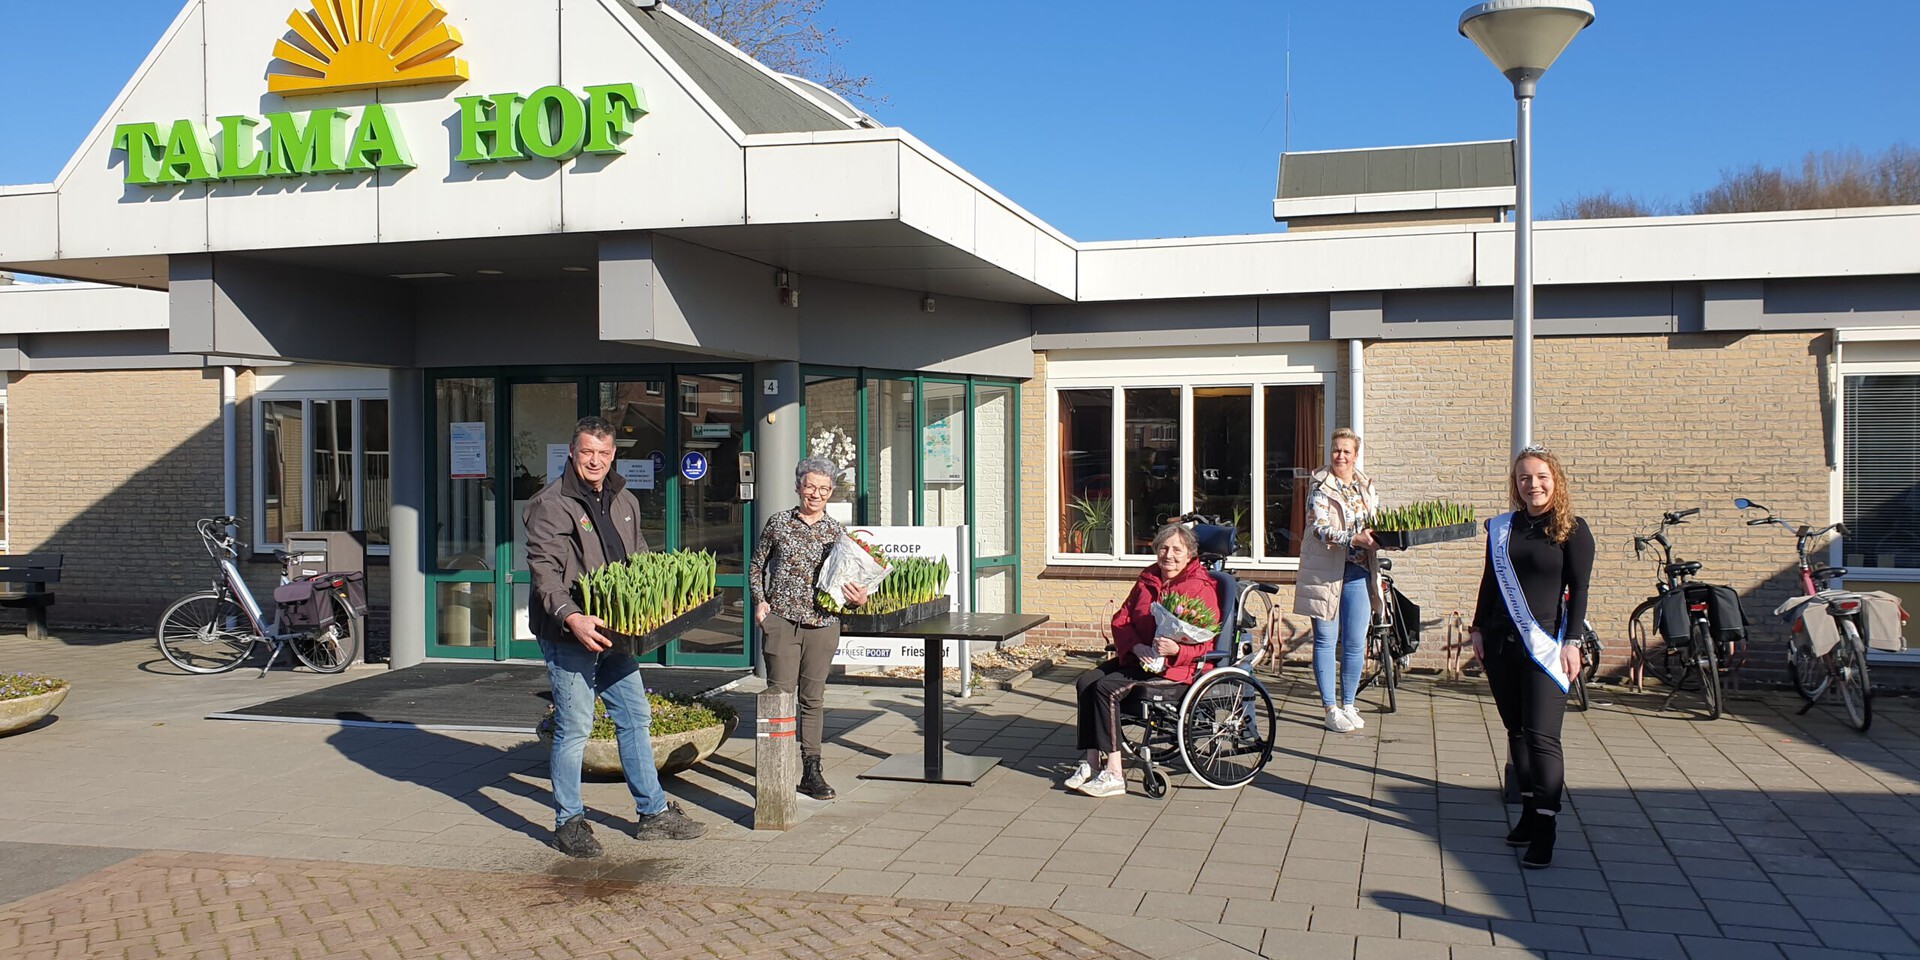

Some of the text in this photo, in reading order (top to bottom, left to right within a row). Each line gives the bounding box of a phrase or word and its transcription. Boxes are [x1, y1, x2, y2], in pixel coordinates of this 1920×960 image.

[113, 82, 650, 187] TALMA HOF
[768, 381, 774, 392] 4
